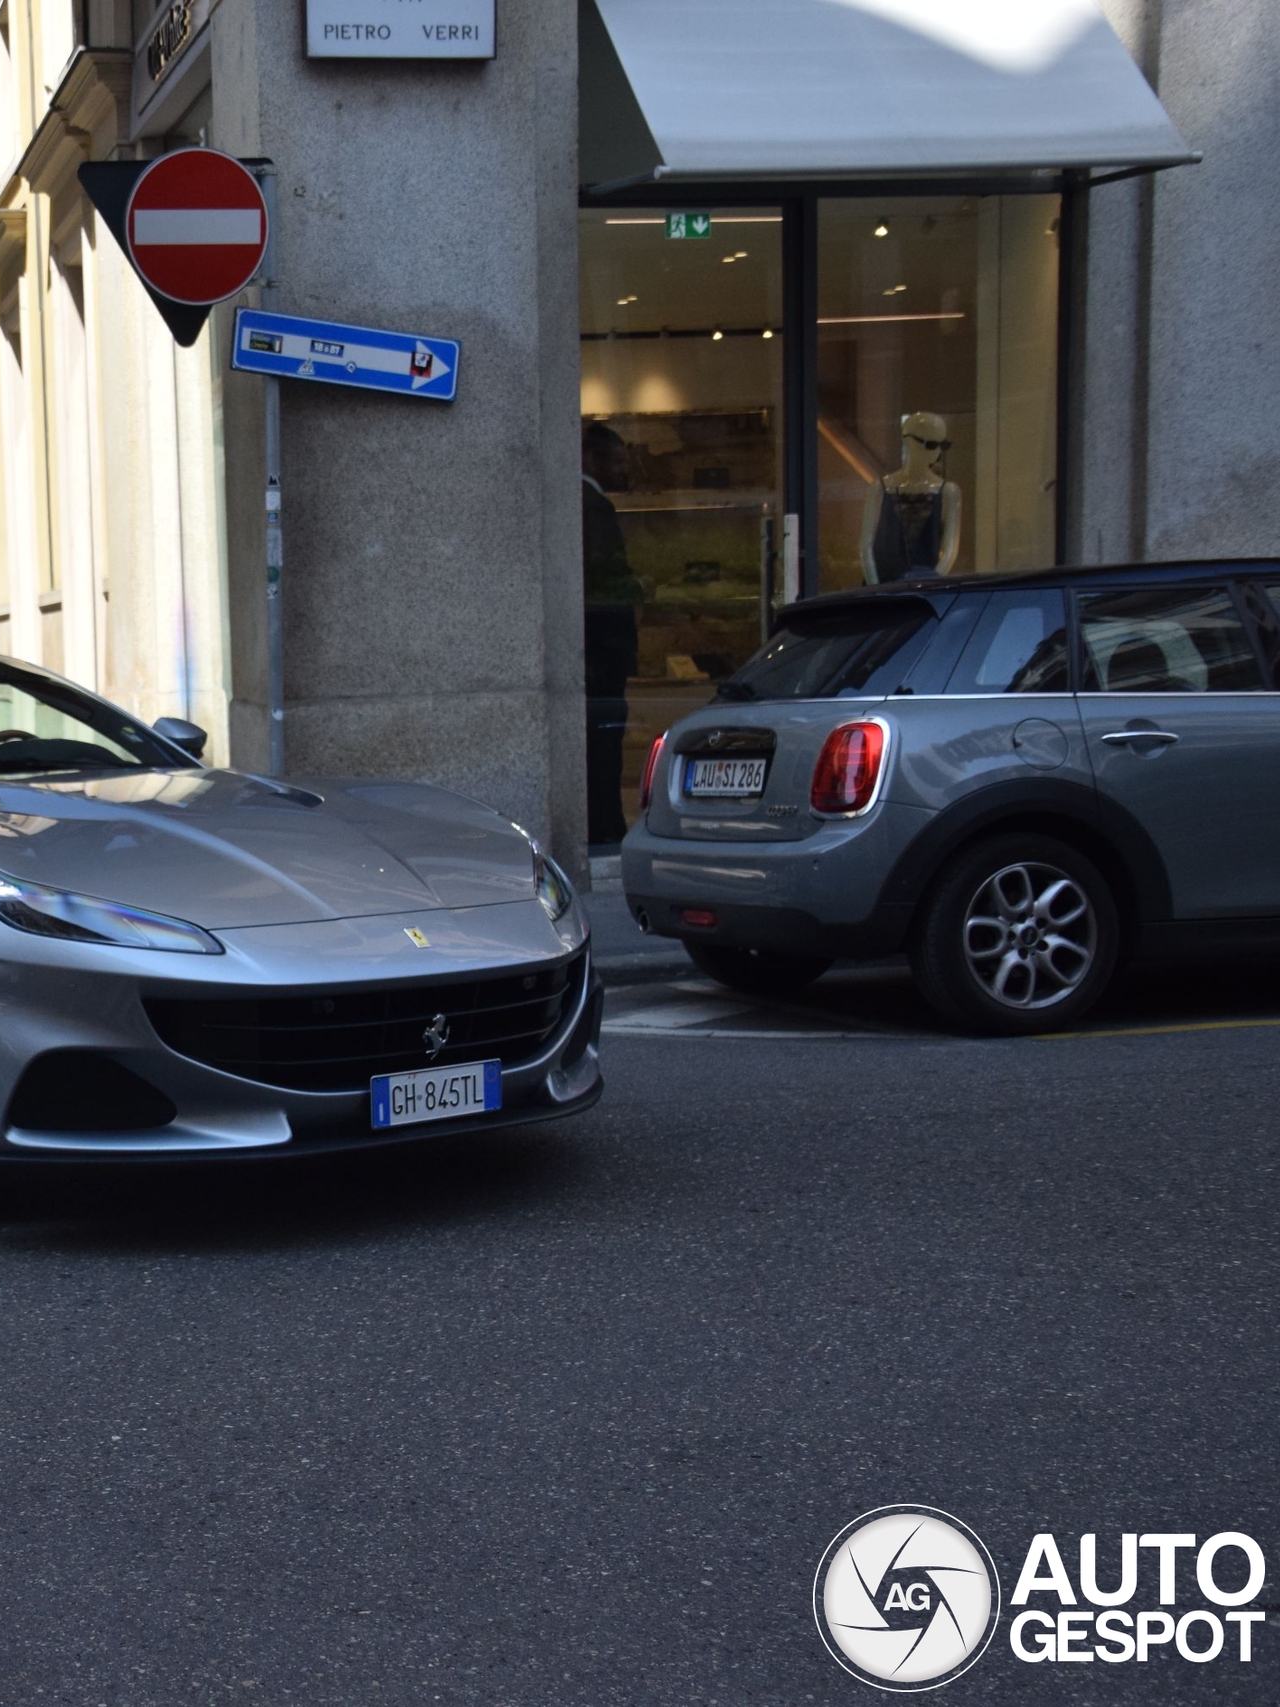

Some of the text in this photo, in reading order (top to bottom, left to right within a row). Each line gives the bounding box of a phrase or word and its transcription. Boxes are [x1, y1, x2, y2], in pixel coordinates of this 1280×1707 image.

[324, 24, 479, 41] PIETRO VERRI
[693, 763, 716, 788] LAU
[739, 763, 762, 788] 286
